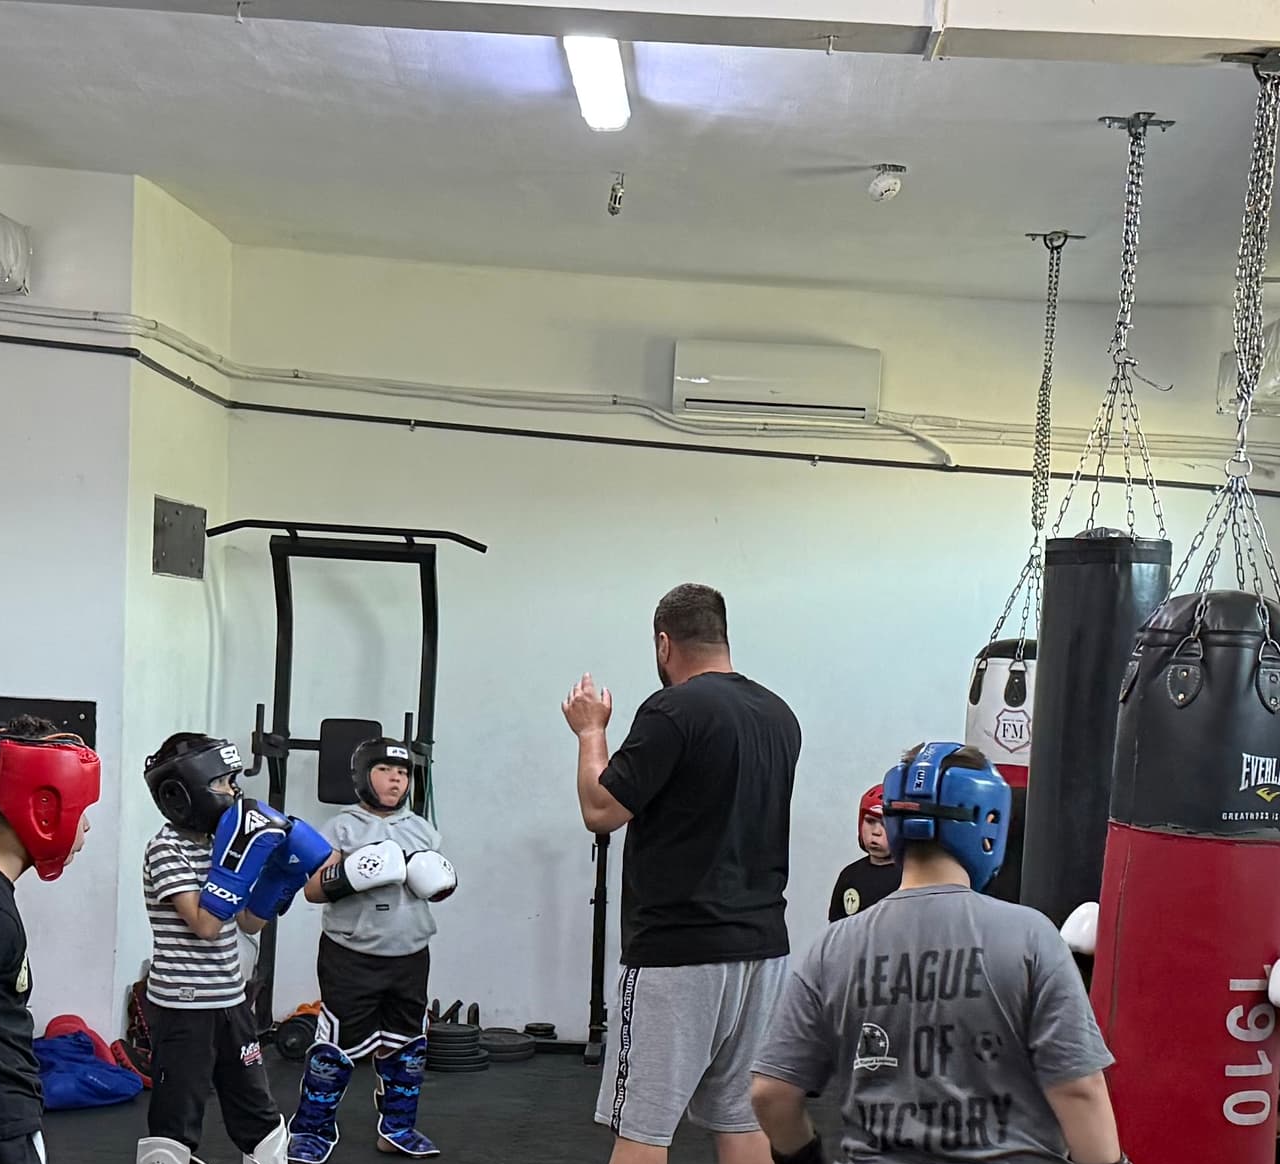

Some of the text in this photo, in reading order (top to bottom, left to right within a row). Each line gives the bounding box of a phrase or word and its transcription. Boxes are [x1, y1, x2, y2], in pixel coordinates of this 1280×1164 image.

[1002, 722, 1024, 739] FM
[1222, 811, 1269, 820] GREATNESS
[203, 881, 243, 905] RDX
[856, 946, 985, 1009] LEAGUE
[914, 1024, 955, 1079] OF
[1223, 963, 1276, 1126] 1910
[857, 1092, 1012, 1152] VICTORY
